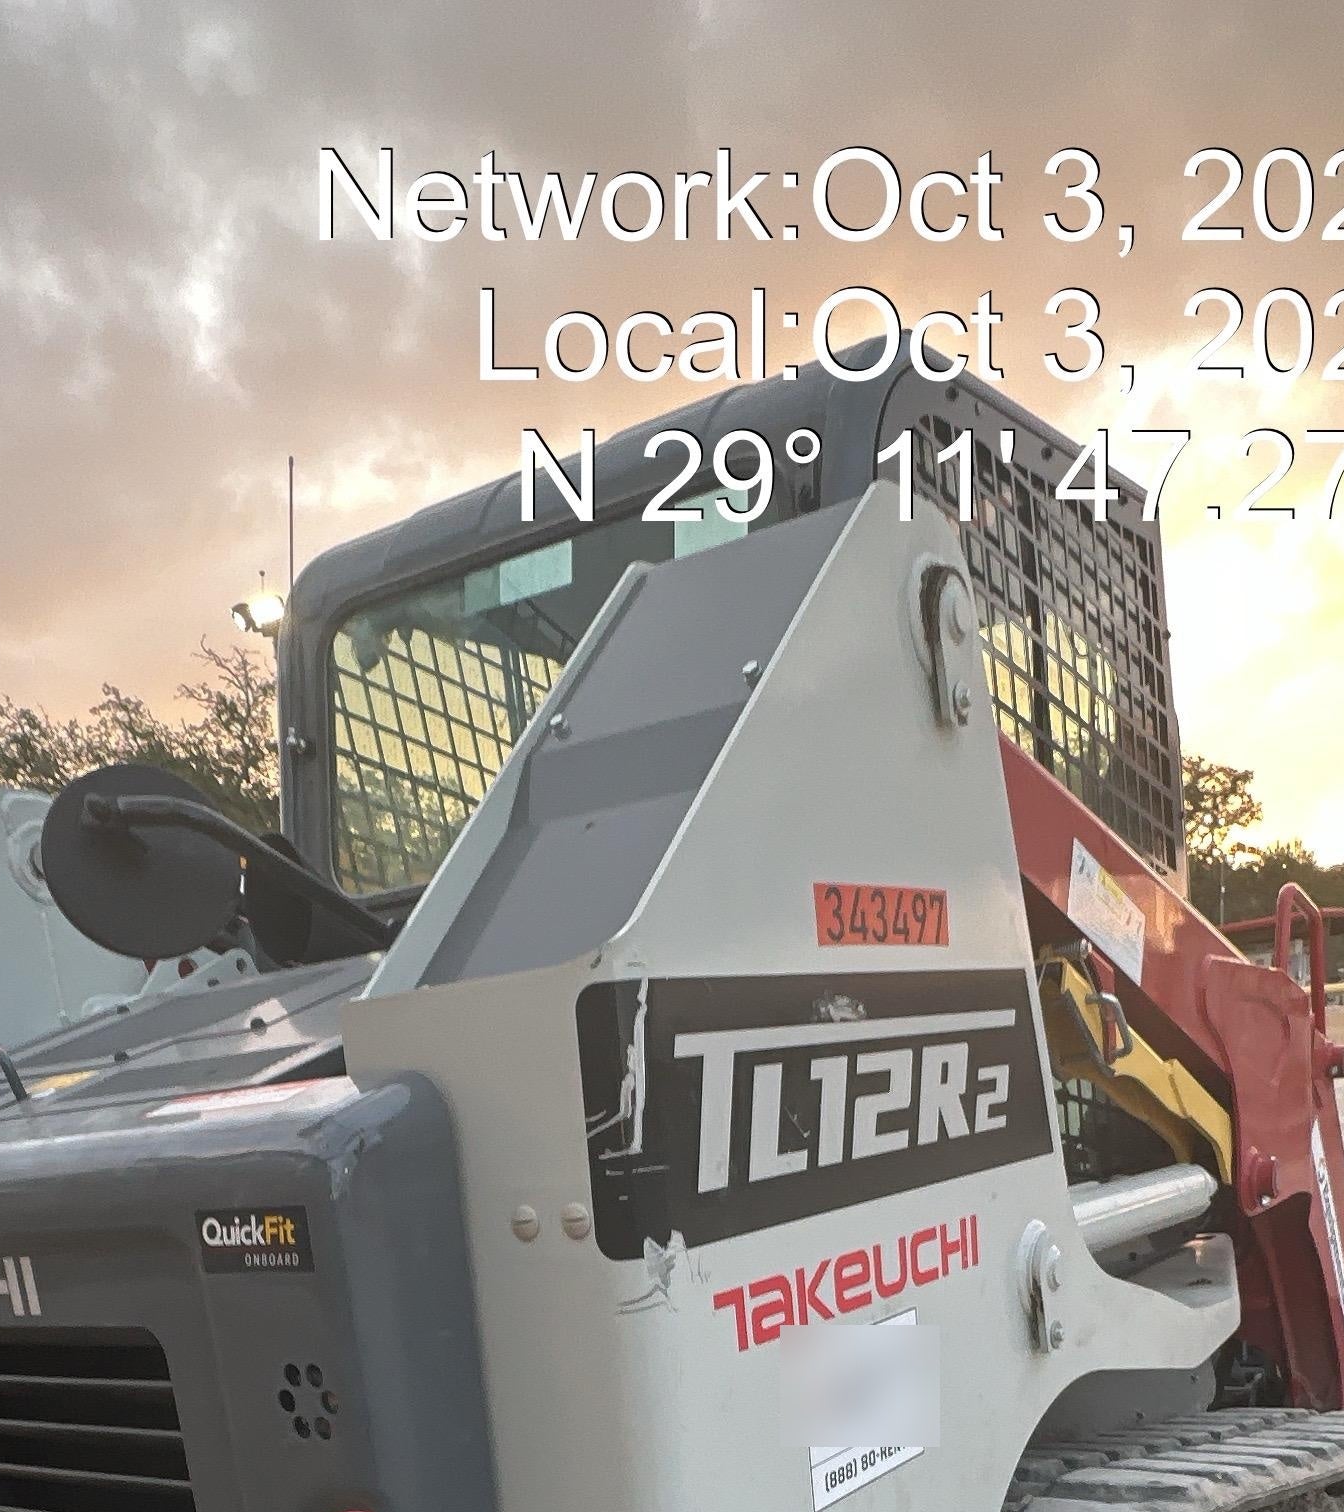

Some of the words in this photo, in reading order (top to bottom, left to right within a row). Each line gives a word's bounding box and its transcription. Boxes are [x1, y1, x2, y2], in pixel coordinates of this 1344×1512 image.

[824, 886, 944, 944] 343497
[674, 1009, 1016, 1194] TL12R2
[201, 1213, 297, 1247] QuickFit
[244, 1252, 300, 1267] ONBOARD
[824, 1457, 858, 1493] (888)
[860, 1446, 906, 1472] 80-RE
